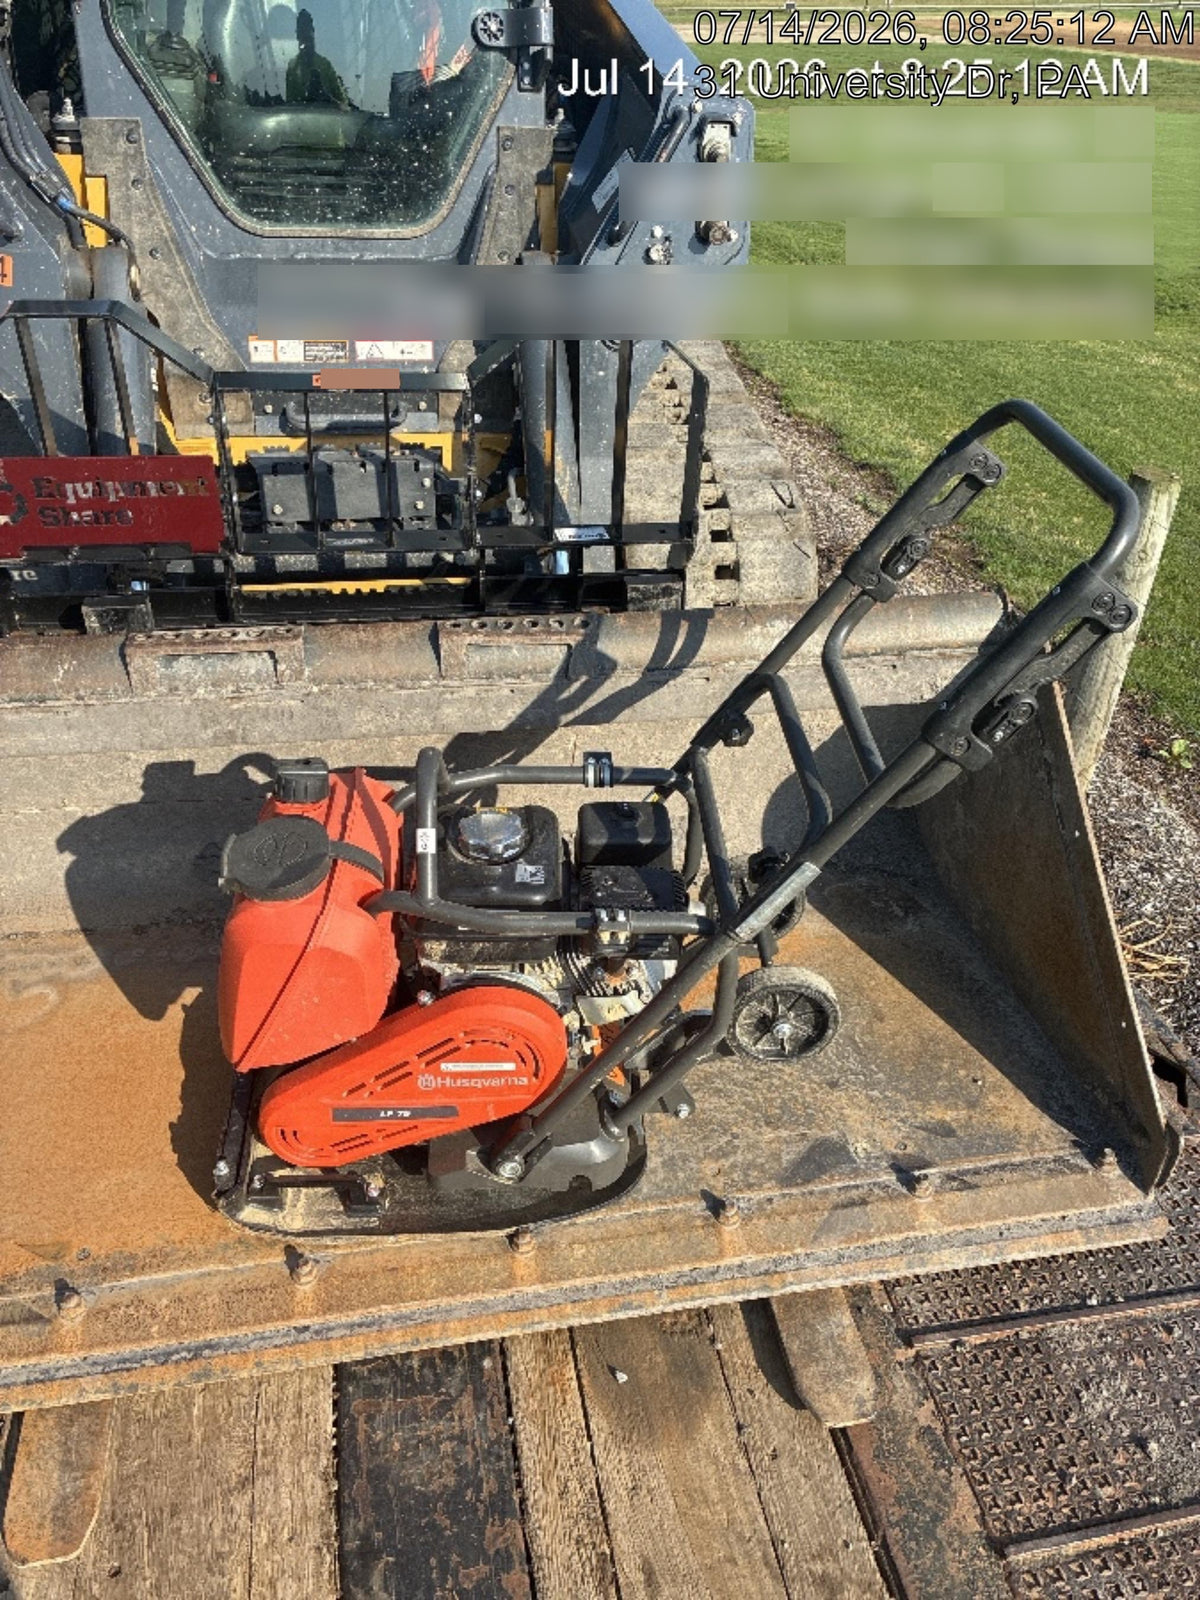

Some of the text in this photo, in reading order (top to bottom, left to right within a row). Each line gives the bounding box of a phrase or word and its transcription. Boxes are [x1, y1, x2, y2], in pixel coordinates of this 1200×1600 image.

[31, 475, 209, 503] Equipment
[37, 505, 134, 527] Share
[436, 1075, 529, 1089] Husqvarna
